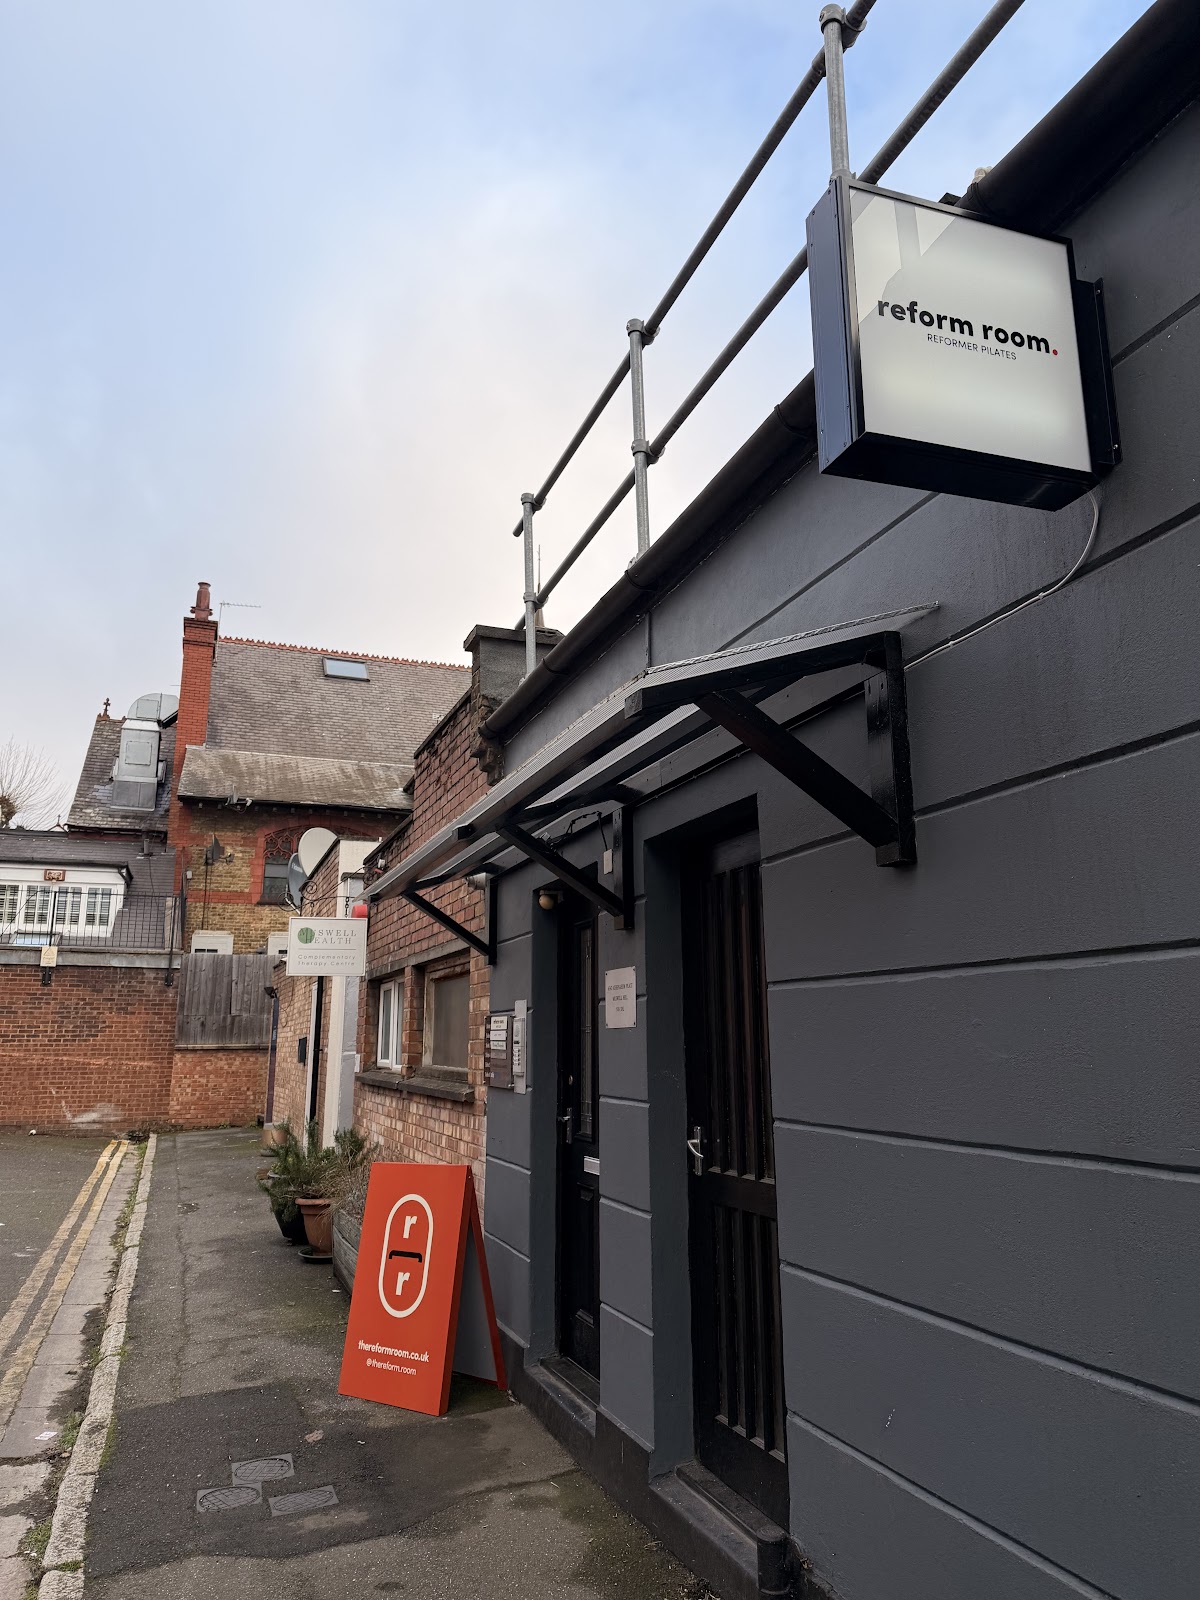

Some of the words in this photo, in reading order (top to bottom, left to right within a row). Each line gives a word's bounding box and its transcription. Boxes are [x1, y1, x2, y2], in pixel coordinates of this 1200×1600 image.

[878, 300, 974, 337] reform
[982, 324, 1058, 356] room.
[927, 333, 979, 352] REFORMER
[981, 346, 1017, 361] PILATES
[403, 1215, 418, 1239] r
[395, 1271, 410, 1296] r
[358, 1339, 430, 1363] thereformroom.co.uk
[366, 1357, 417, 1376] @thereform.room
